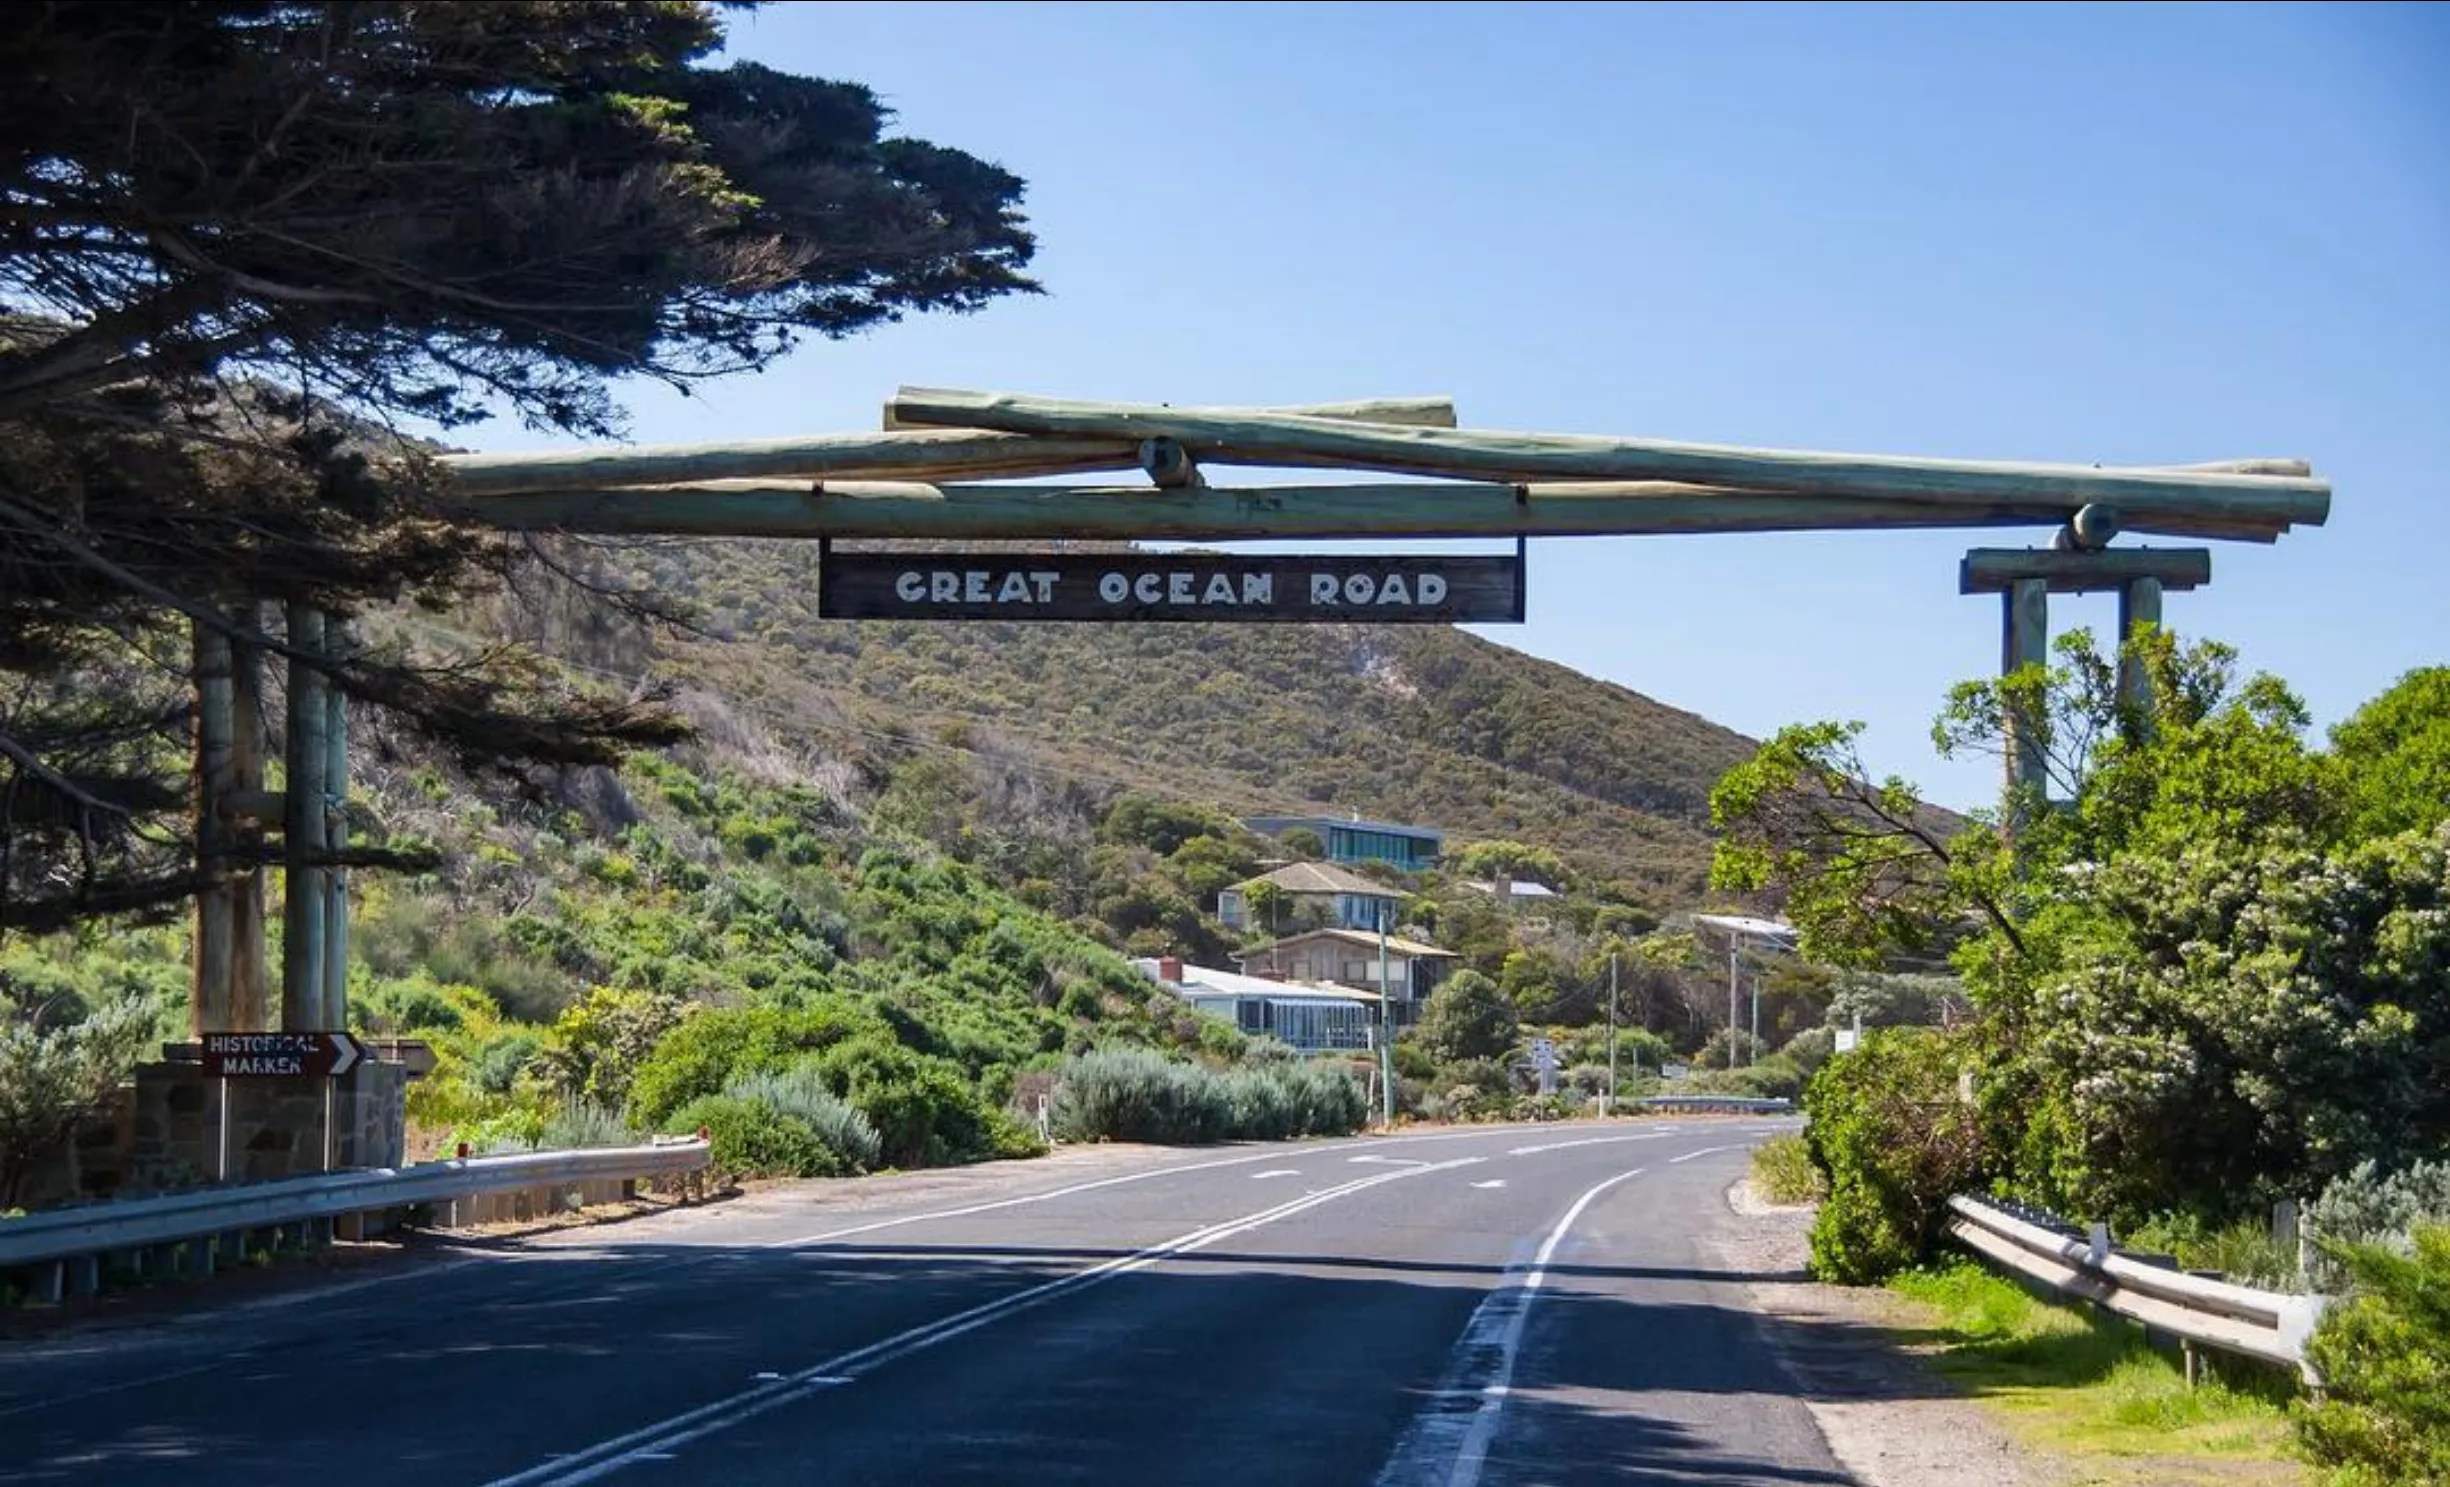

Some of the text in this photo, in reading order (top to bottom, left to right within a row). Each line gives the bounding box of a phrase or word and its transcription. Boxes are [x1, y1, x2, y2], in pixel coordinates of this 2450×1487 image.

[896, 571, 1447, 605] GREAT OCEAN ROAD
[223, 1057, 302, 1075] MARKER
